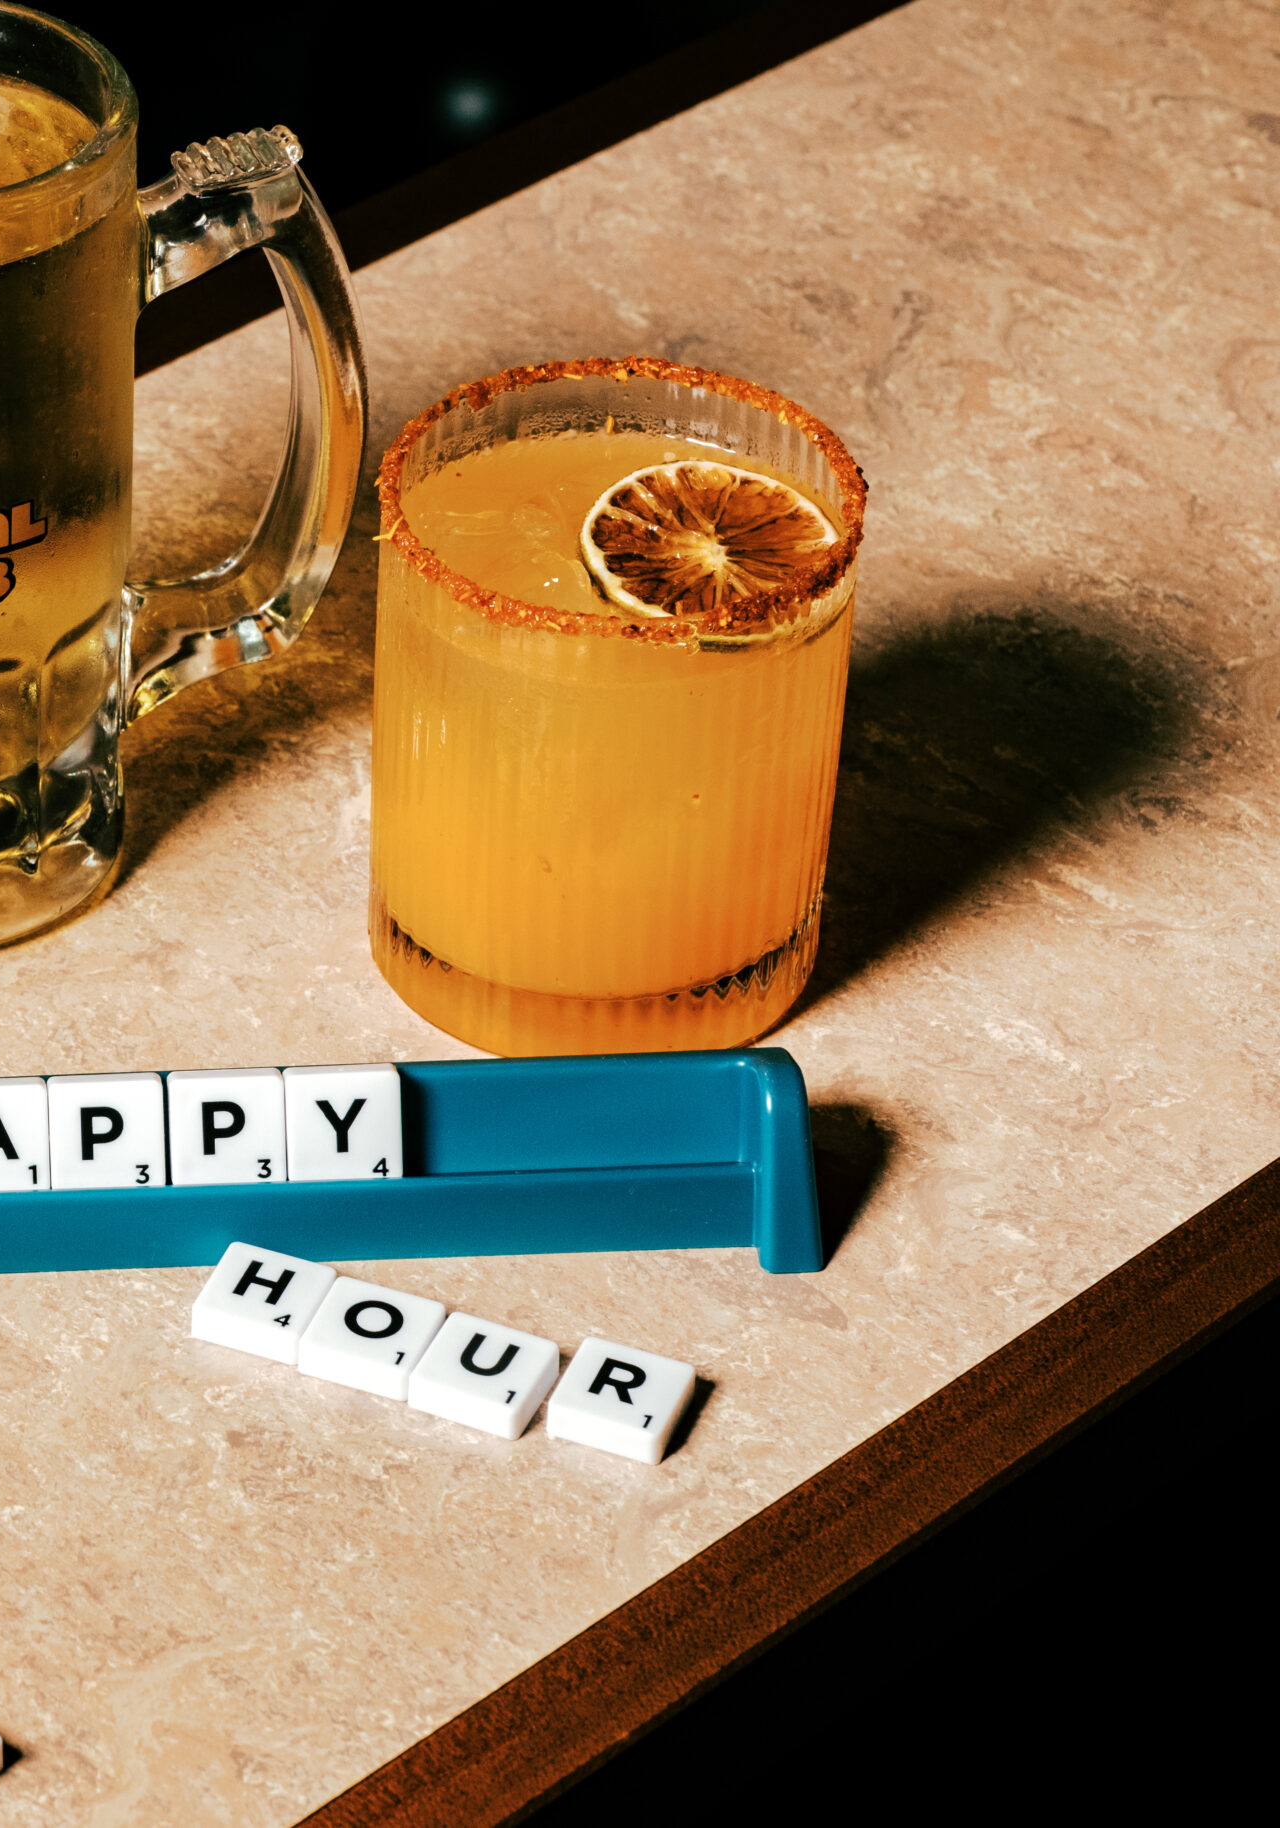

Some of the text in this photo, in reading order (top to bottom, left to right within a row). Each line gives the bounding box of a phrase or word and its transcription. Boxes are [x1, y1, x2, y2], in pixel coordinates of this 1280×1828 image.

[27, 1164, 38, 1185] 1
[135, 1164, 150, 1185] 3
[257, 1158, 272, 1179] 3
[372, 1157, 390, 1177] 4
[273, 1313, 292, 1328] 4
[394, 1351, 405, 1366] 1
[505, 1390, 517, 1404] 1
[641, 1414, 653, 1429] 1
